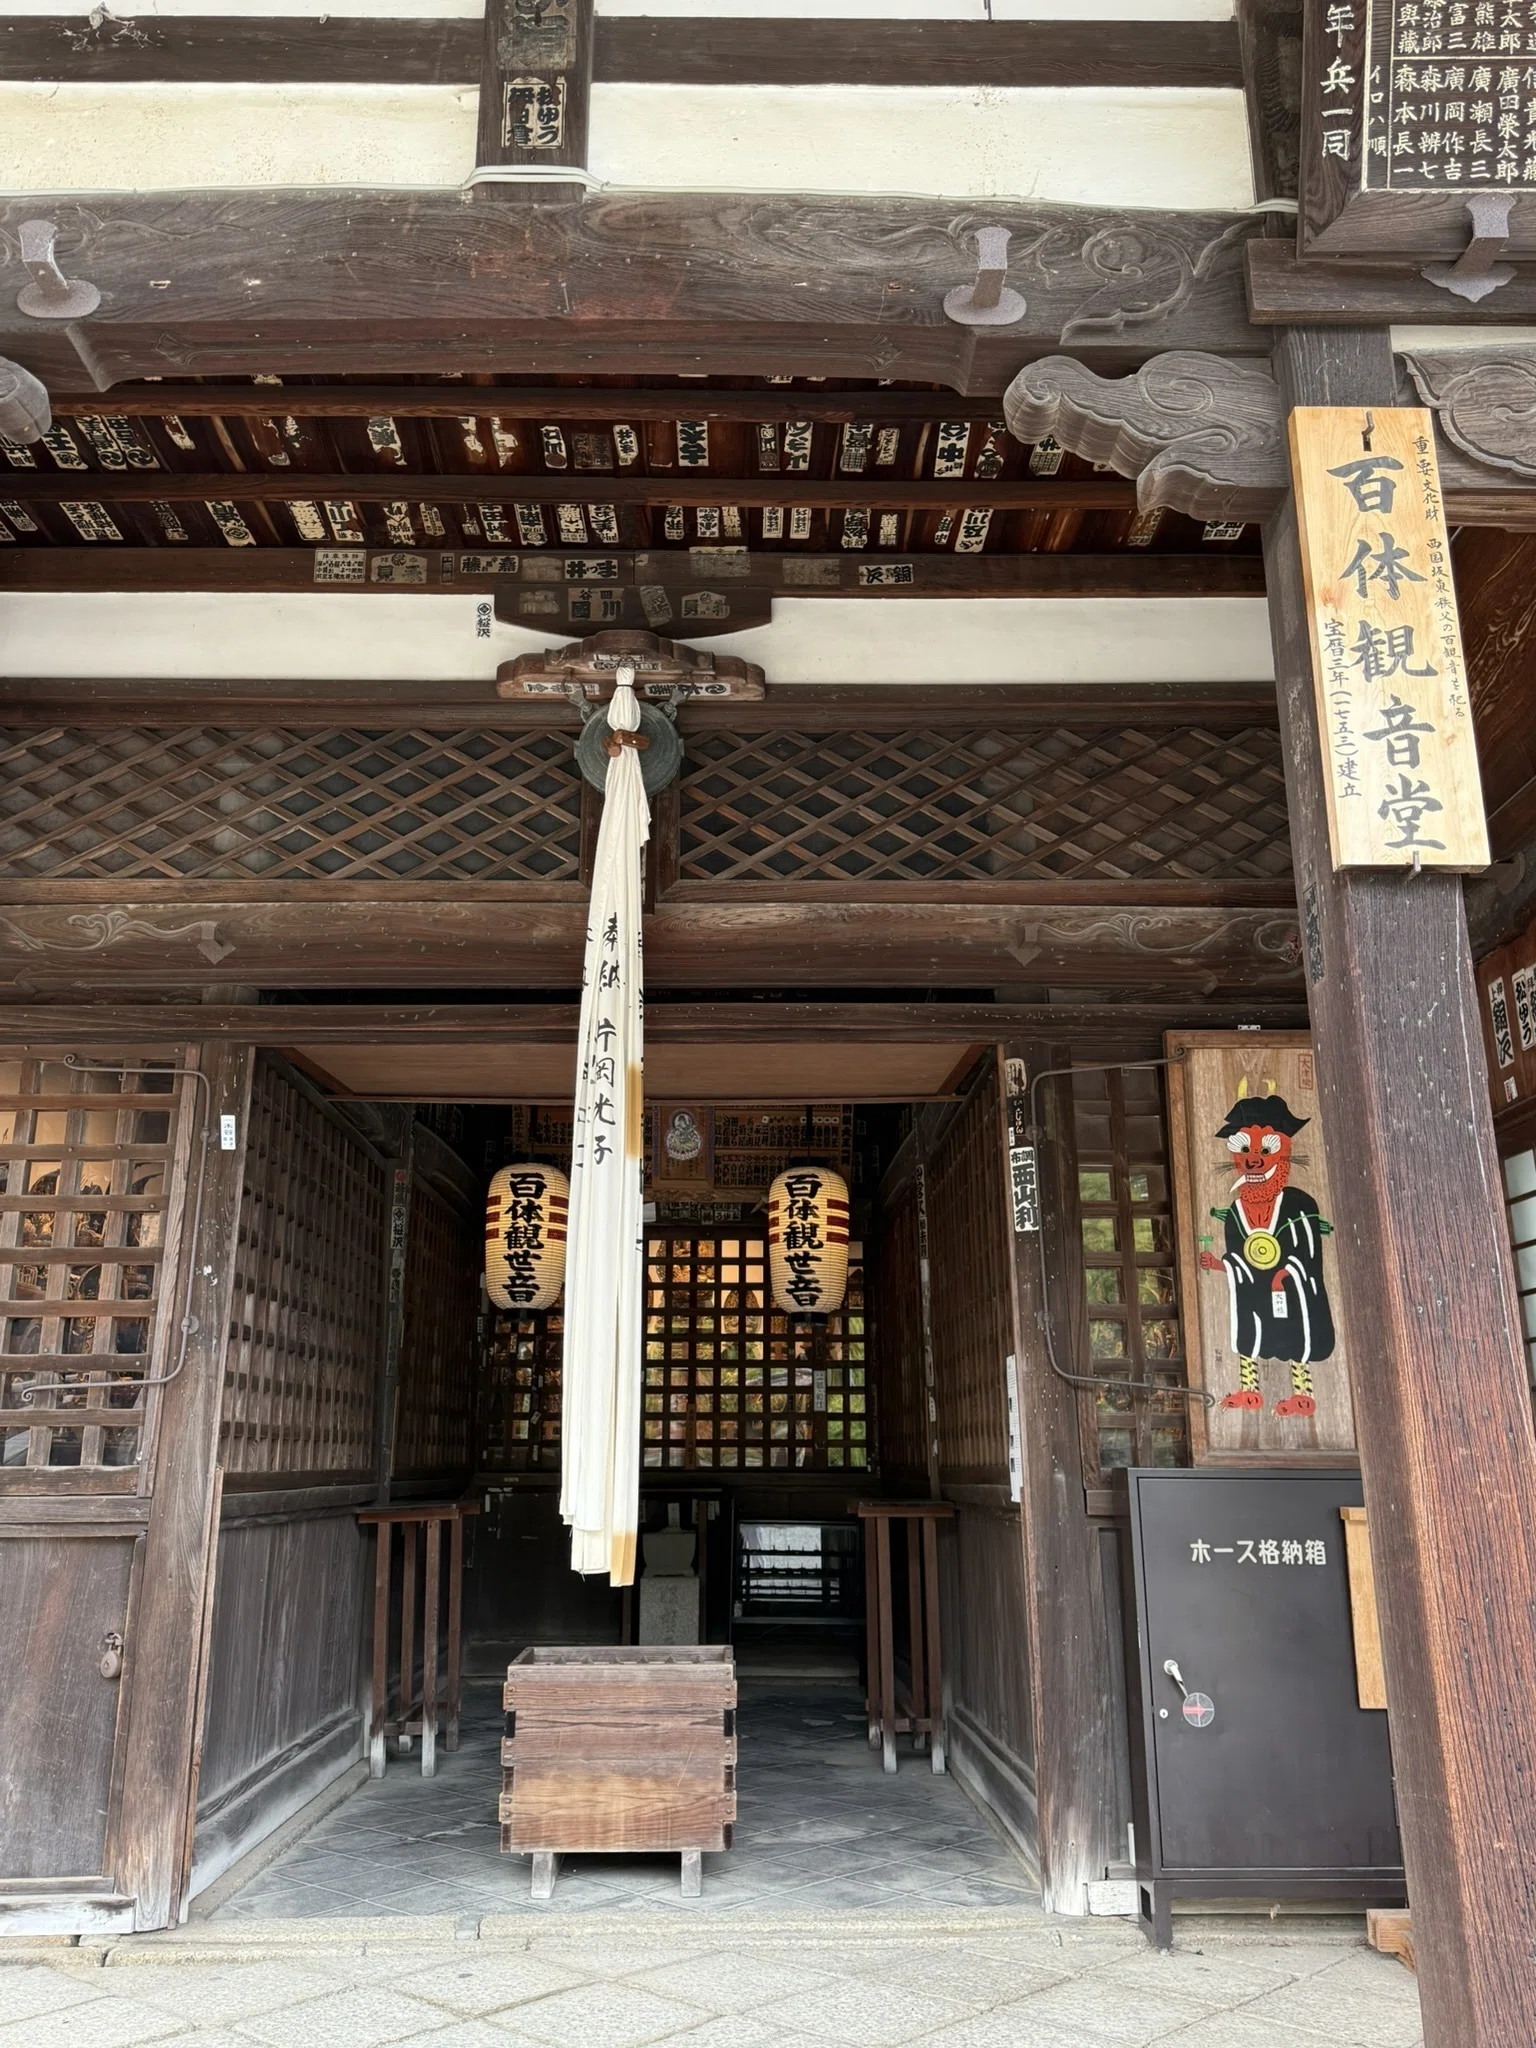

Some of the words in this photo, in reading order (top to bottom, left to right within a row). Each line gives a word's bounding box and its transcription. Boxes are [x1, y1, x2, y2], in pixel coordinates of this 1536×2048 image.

[1394, 64, 1420, 174] 森本長一
[1411, 435, 1440, 523] 重要文化財
[1326, 455, 1447, 851] 百体観音堂
[502, 1172, 548, 1303] 百体観世音
[783, 1173, 824, 1307] 百体観世音
[1189, 1538, 1327, 1566] ホース格納箱
